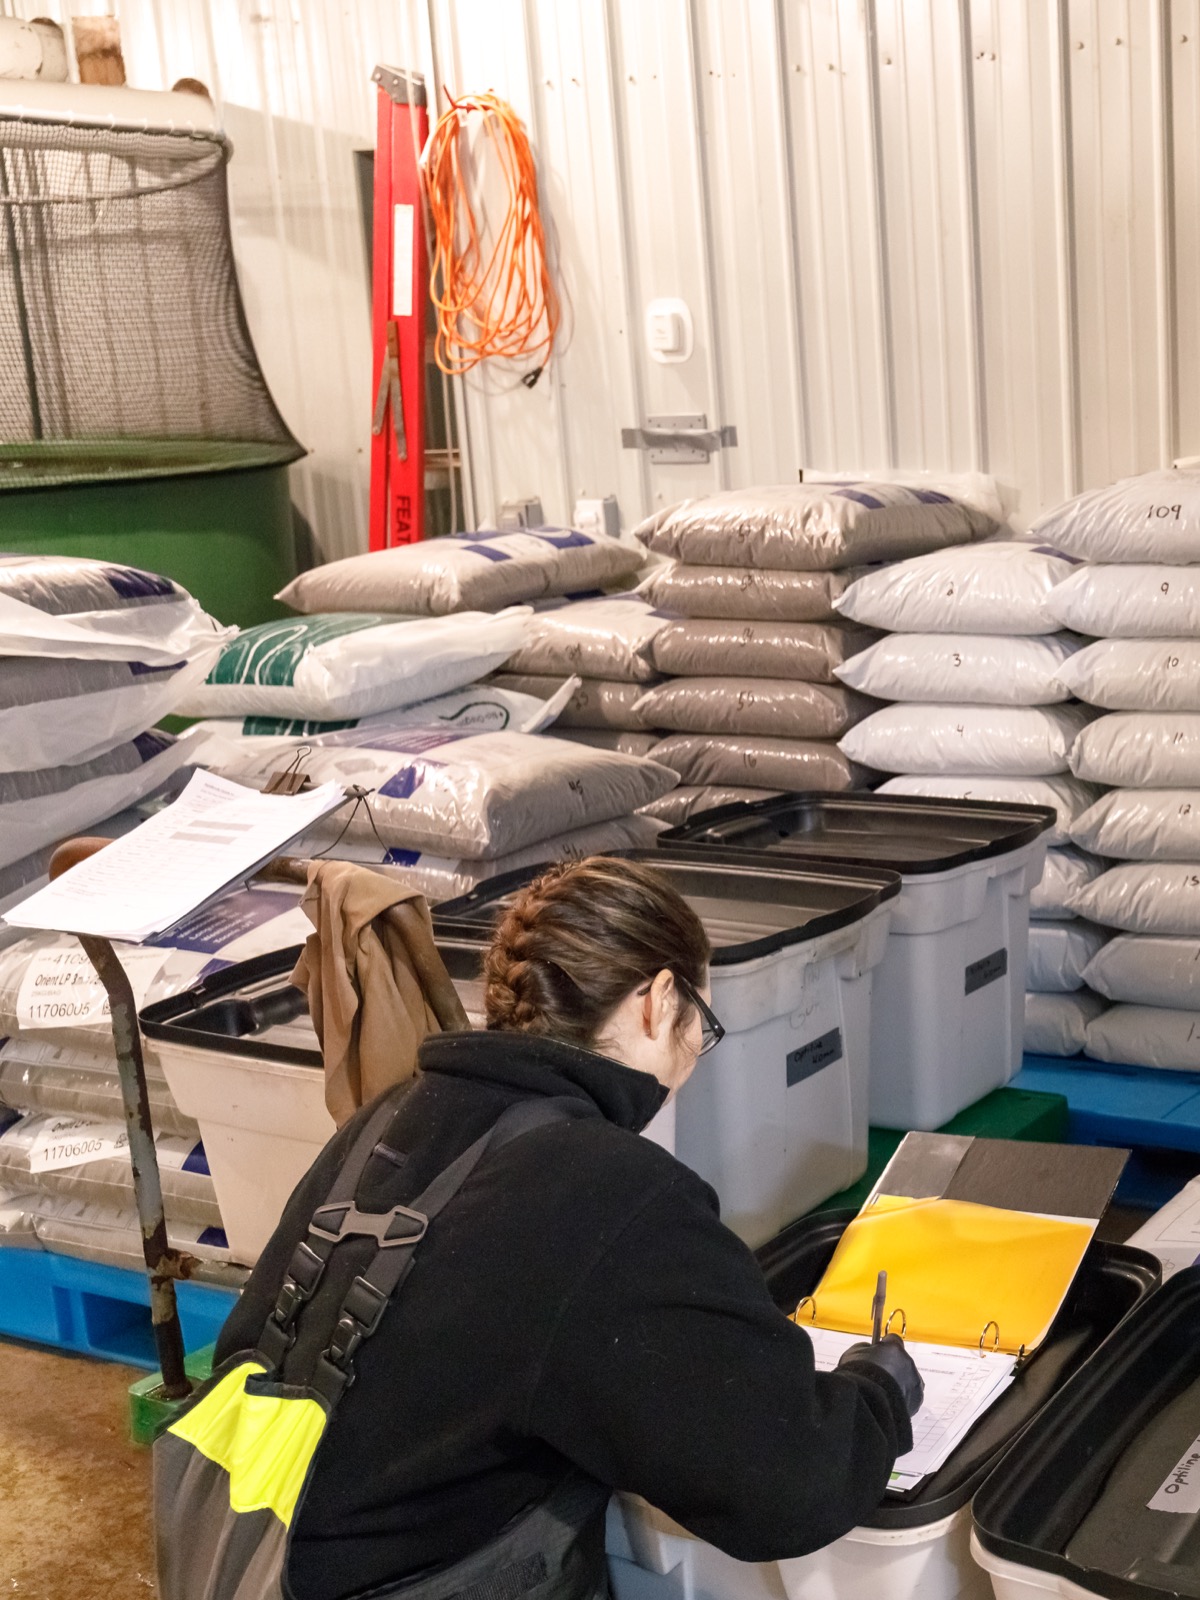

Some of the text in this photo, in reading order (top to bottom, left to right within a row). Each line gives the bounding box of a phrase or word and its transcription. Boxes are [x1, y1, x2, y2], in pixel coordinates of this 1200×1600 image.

[1147, 504, 1182, 520] 109
[1160, 582, 1170, 595] 9
[952, 653, 962, 668] 3
[1166, 656, 1179, 669] 10
[956, 724, 965, 738] 4
[1173, 732, 1184, 744] 11
[1178, 804, 1191, 816] 12
[53, 953, 92, 966] 4109
[35, 974, 58, 987] Orient
[58, 973, 71, 986] LP
[43, 1138, 105, 1161] 11706005
